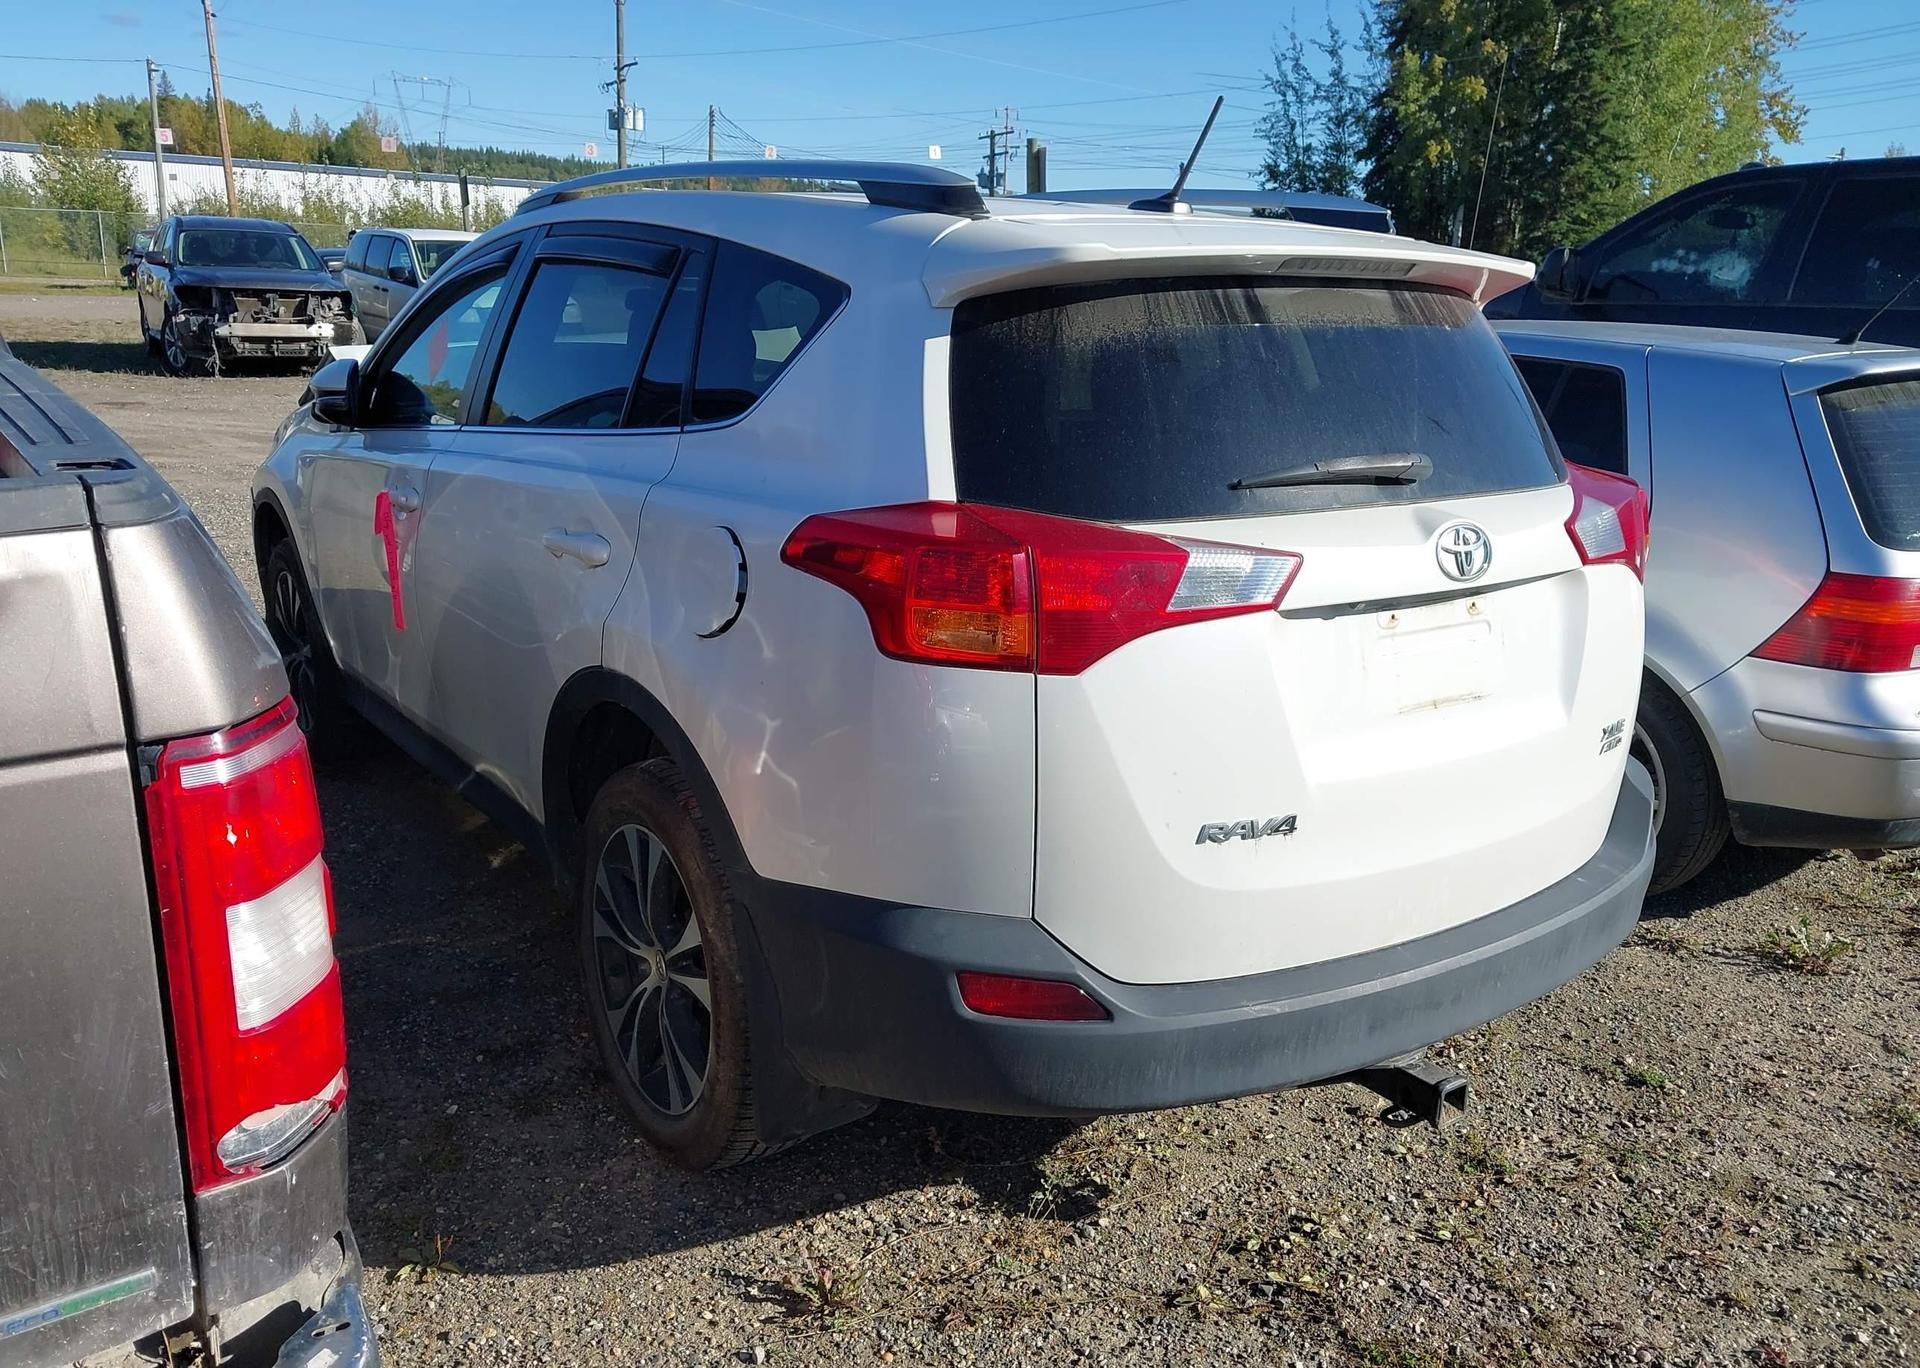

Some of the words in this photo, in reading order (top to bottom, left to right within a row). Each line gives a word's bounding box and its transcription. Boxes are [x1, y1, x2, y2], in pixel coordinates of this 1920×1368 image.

[160, 130, 169, 142] 5
[587, 144, 594, 156] 3
[767, 146, 774, 158] 2
[1195, 814, 1298, 844] RAV4
